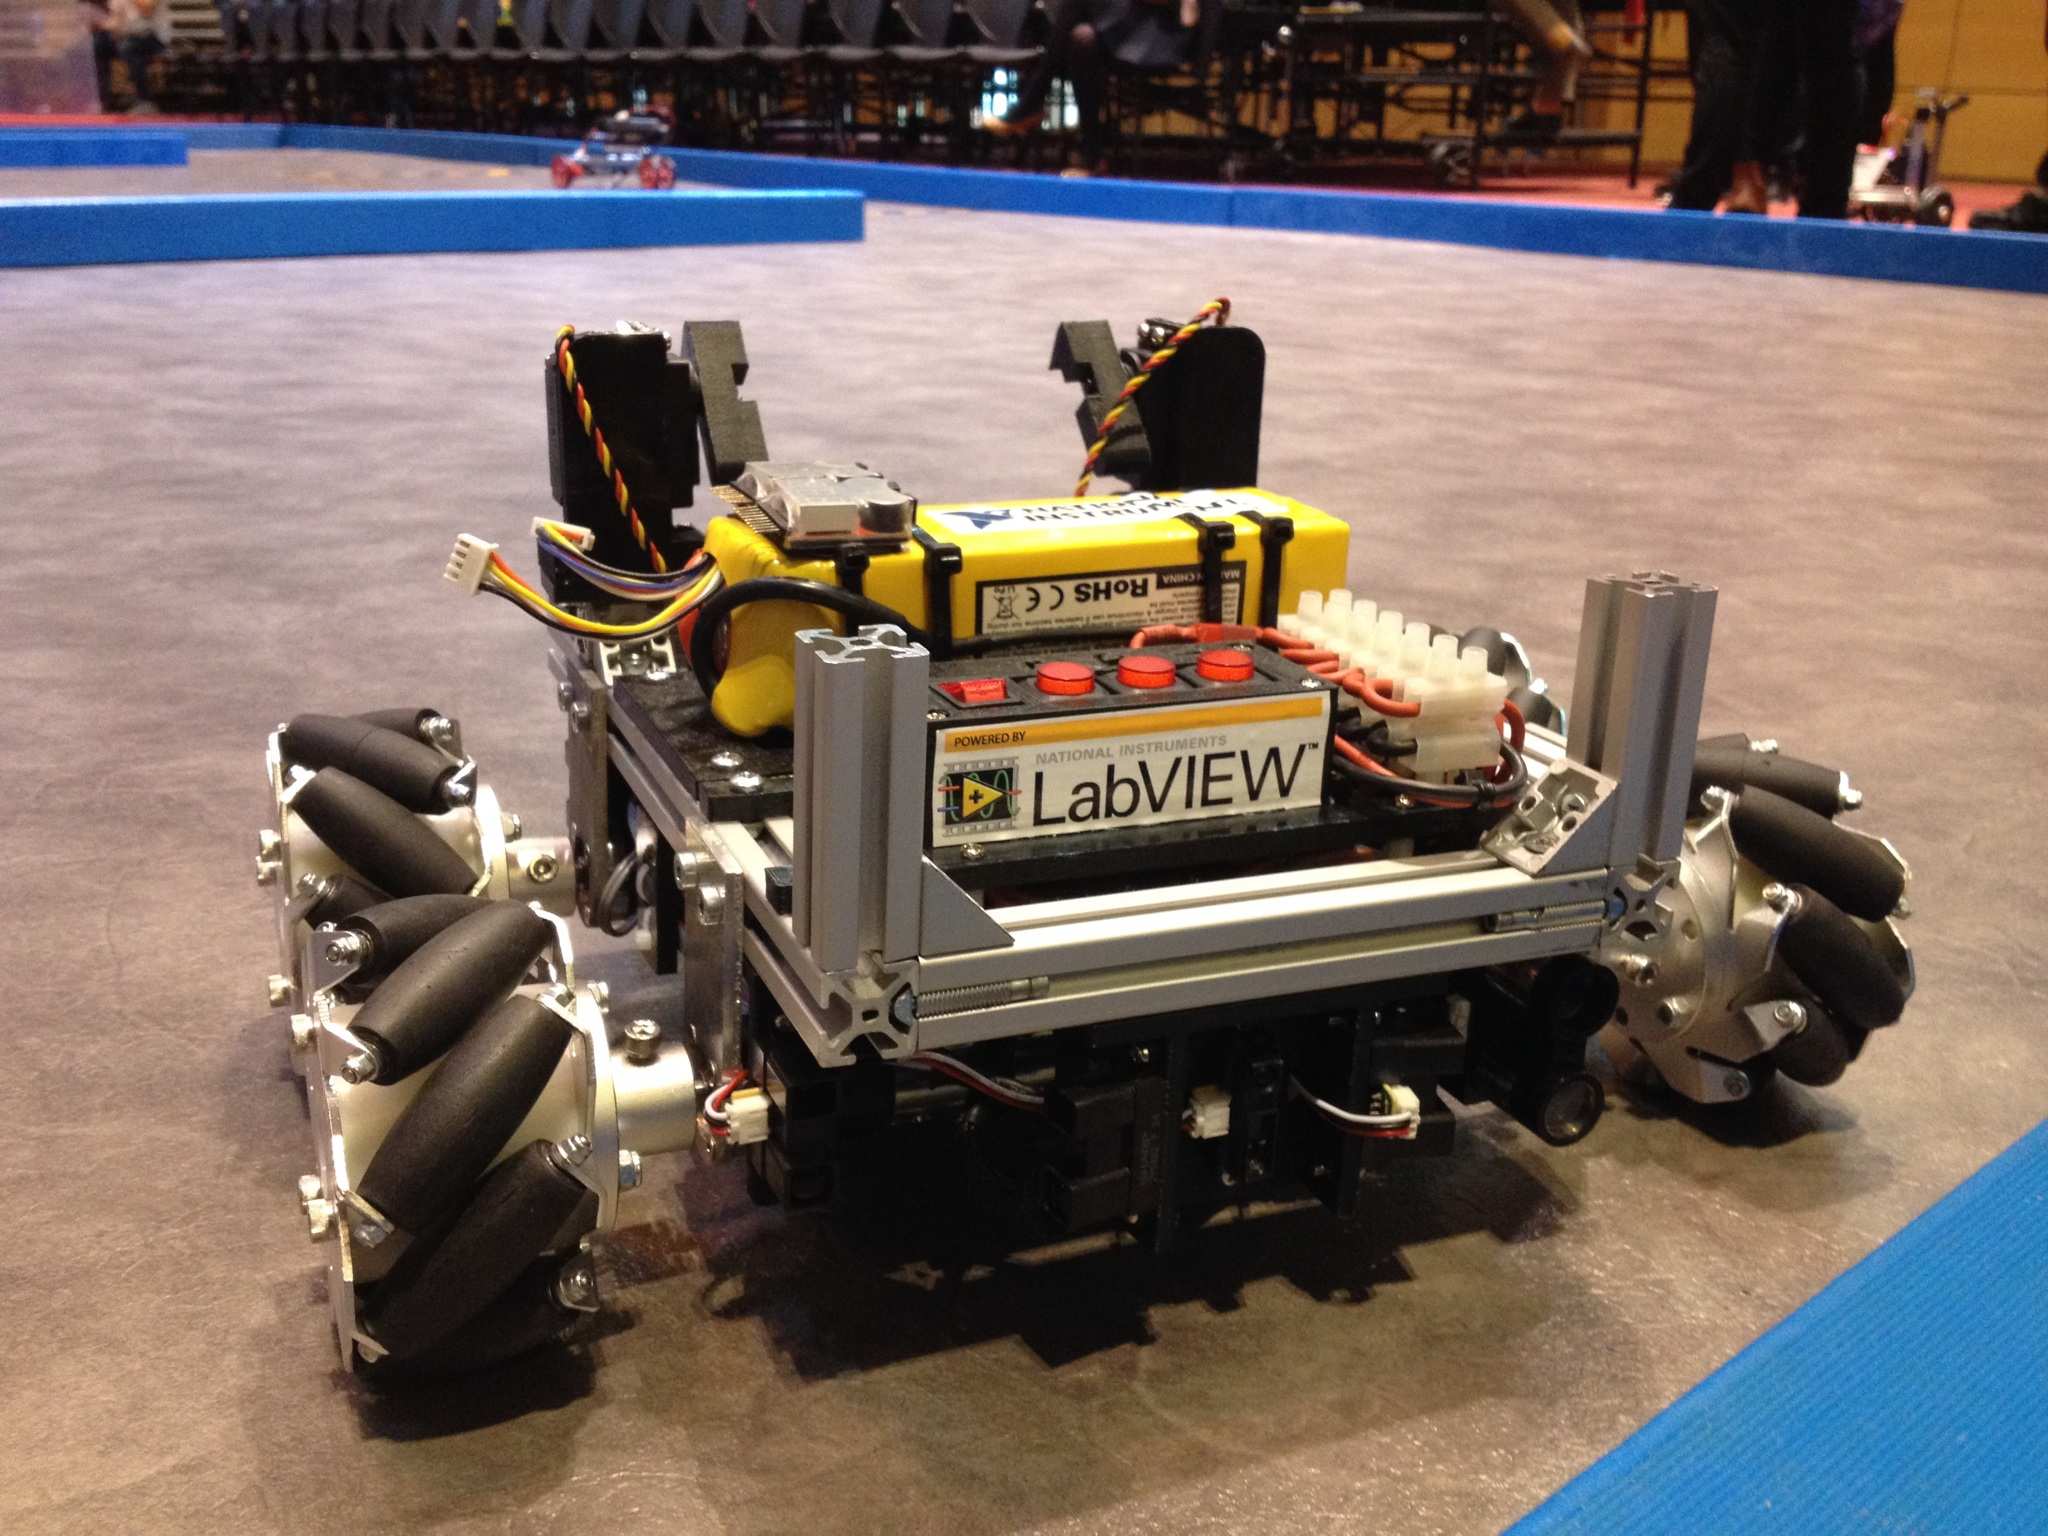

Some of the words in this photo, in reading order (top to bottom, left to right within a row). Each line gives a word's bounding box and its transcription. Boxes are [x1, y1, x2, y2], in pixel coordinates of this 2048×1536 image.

[1162, 573, 1195, 585] CHINA
[1073, 578, 1149, 604] RoHS
[953, 732, 1010, 748] POWERED
[1011, 730, 1027, 744] BY
[1035, 746, 1115, 765] NATIONAL
[1119, 735, 1227, 757] INSTRUMENTS
